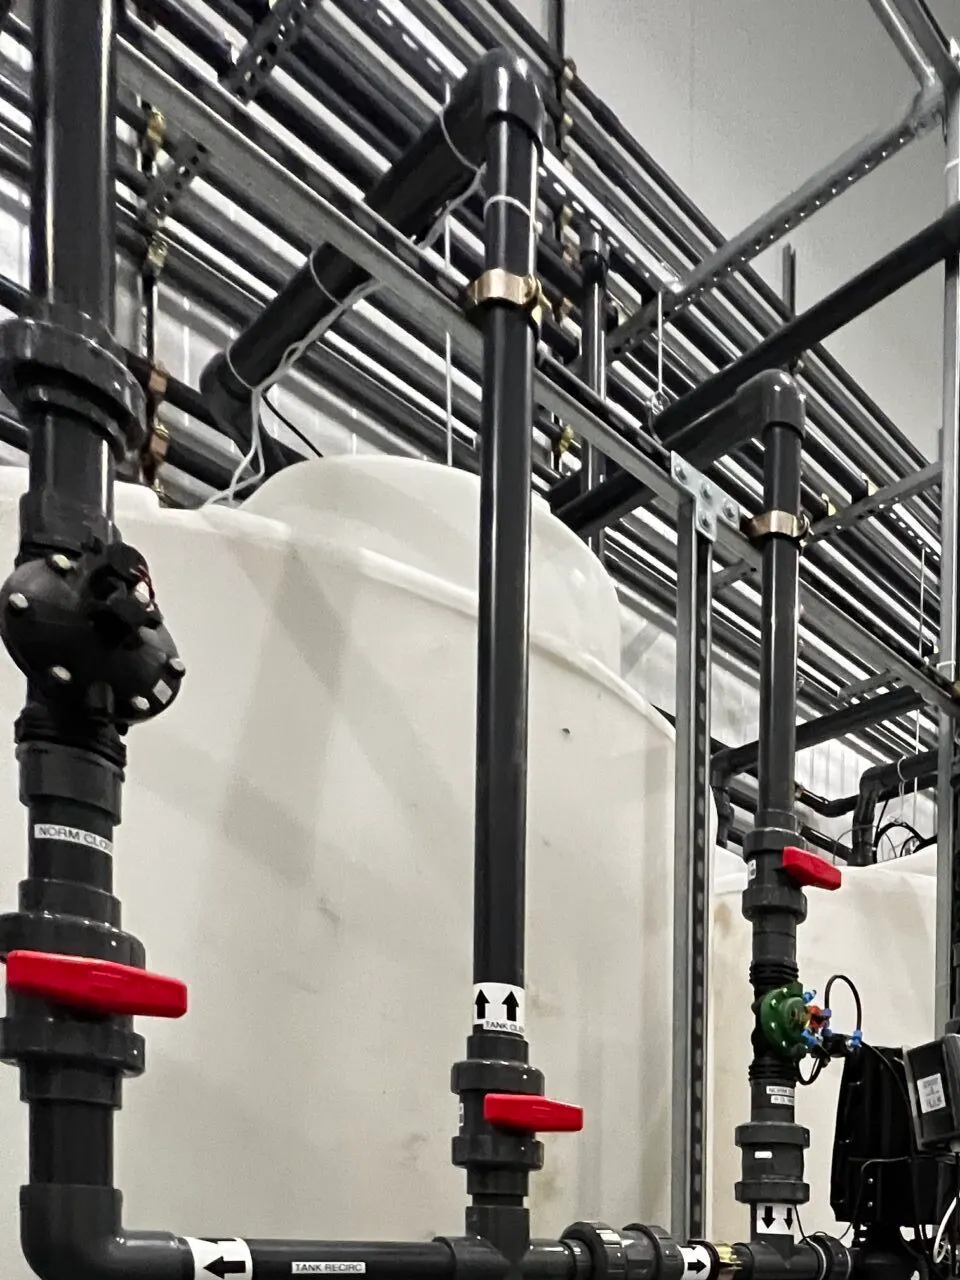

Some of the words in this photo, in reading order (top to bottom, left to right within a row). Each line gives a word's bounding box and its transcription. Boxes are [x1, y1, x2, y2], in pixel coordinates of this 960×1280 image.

[39, 826, 80, 841] NORM
[485, 1020, 508, 1030] TANK
[295, 1263, 322, 1272] TANK
[324, 1263, 363, 1272] RECIRC
